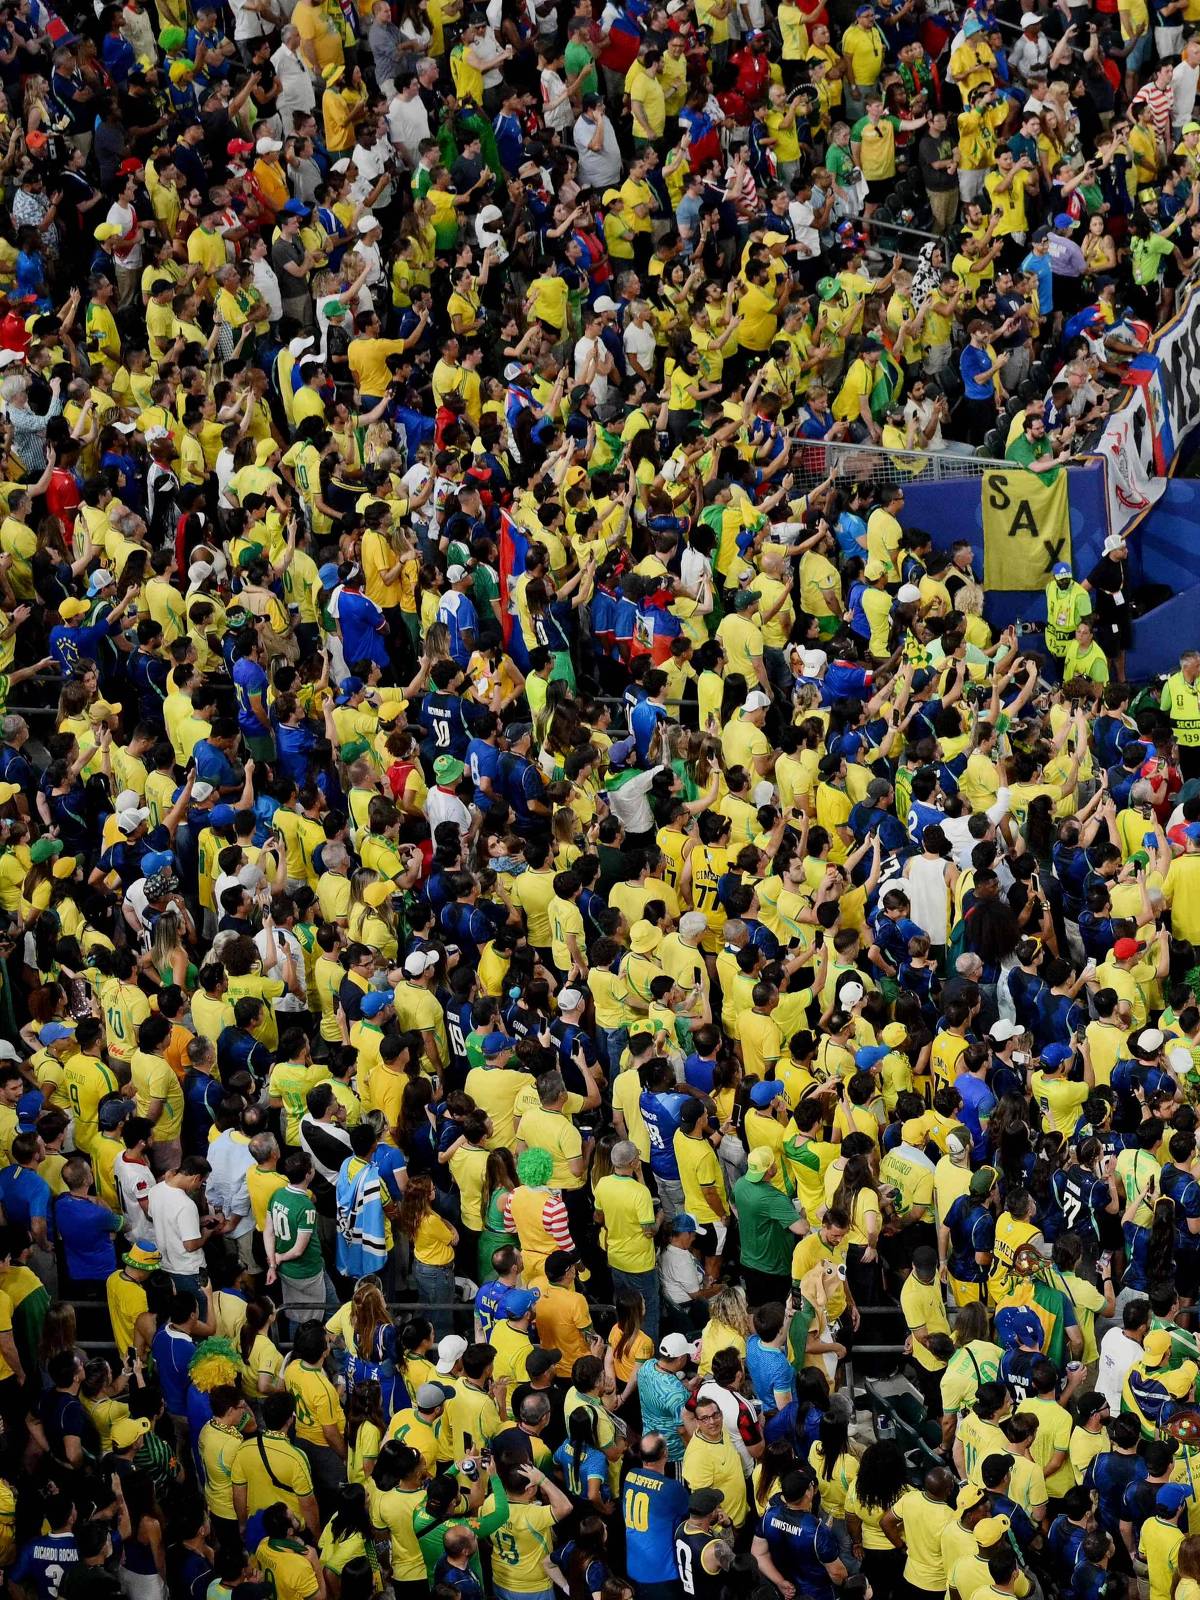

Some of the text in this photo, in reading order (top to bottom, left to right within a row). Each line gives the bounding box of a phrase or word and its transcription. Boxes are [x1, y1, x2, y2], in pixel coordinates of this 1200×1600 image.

[432, 718, 451, 748] 10
[69, 1083, 81, 1118] 9
[273, 1200, 291, 1214] PELE
[304, 1208, 317, 1225] 10
[1063, 1191, 1082, 1230] 77
[271, 1208, 292, 1241] 10
[625, 1488, 650, 1532] 10
[33, 1545, 79, 1562] RICARDO ROCHA
